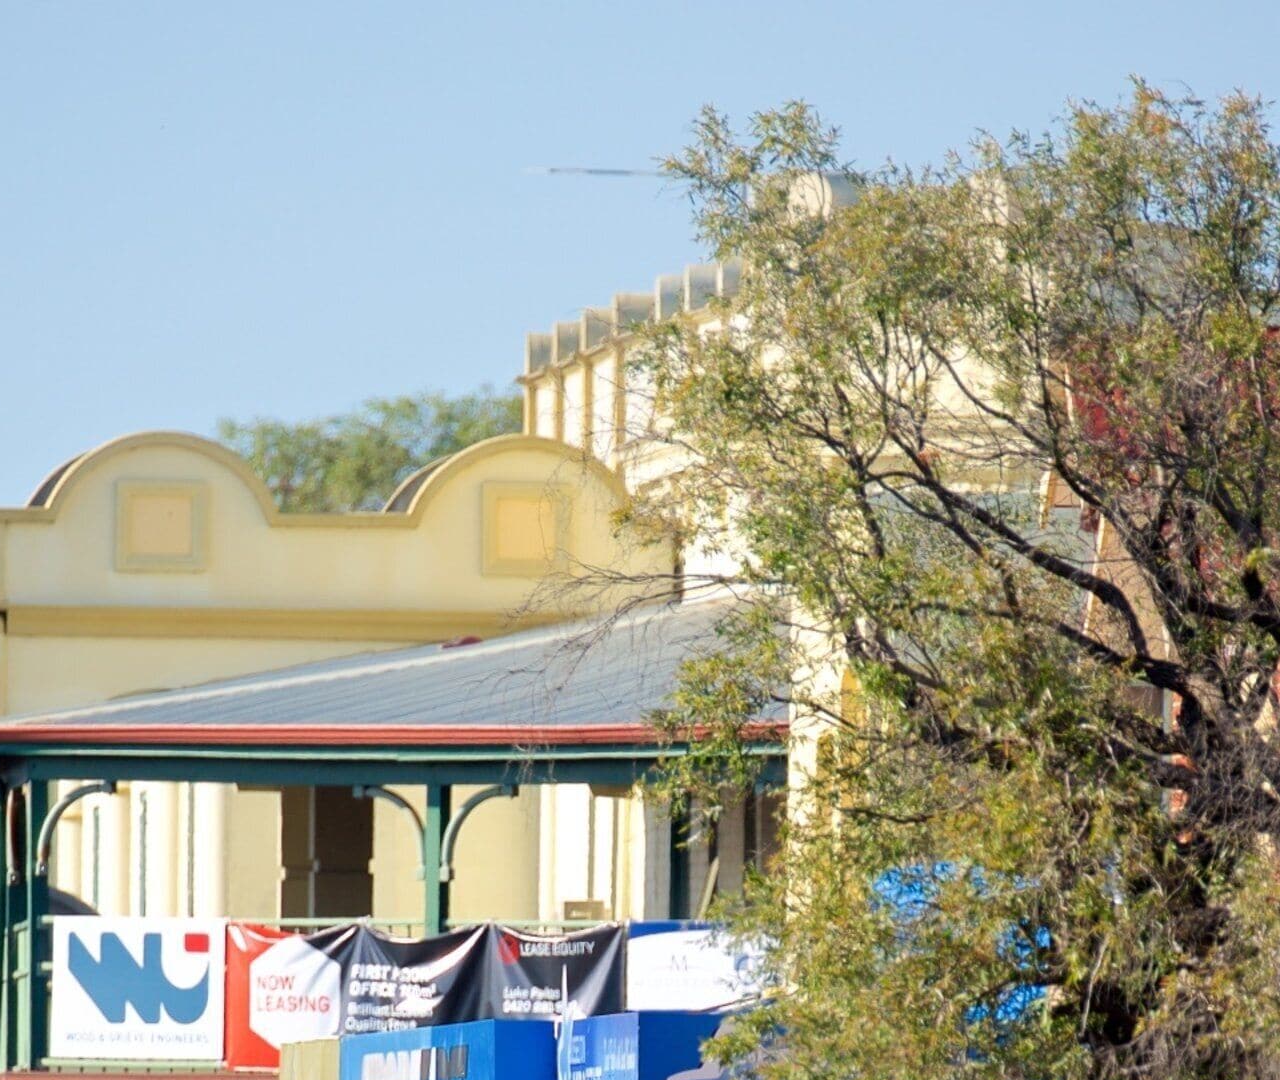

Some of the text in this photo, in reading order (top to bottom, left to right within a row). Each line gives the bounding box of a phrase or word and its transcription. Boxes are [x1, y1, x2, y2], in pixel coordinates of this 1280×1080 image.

[520, 941, 594, 956] LEASE EQUITY
[257, 976, 294, 990] NOW
[256, 996, 330, 1014] LEASING
